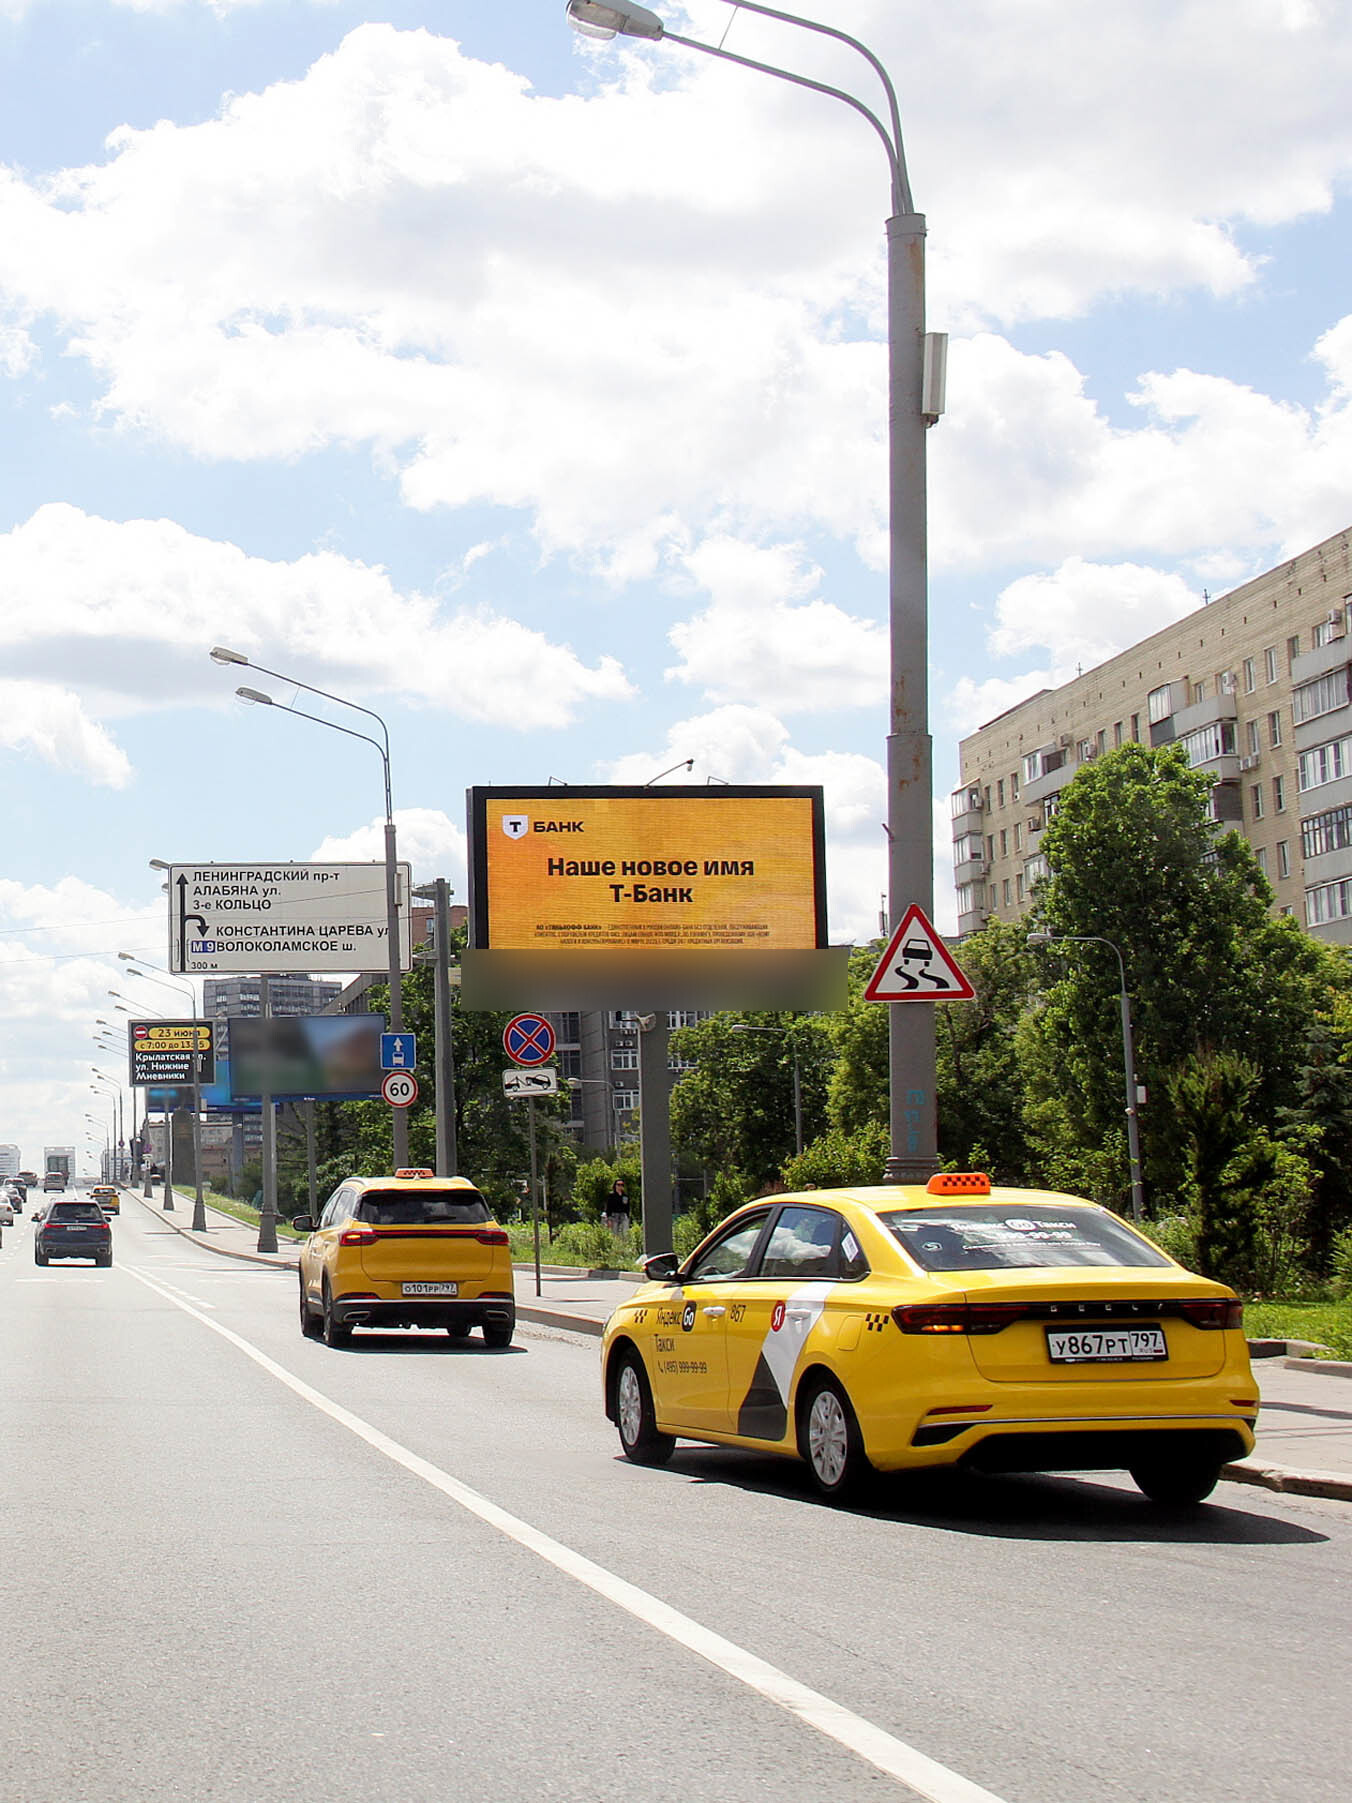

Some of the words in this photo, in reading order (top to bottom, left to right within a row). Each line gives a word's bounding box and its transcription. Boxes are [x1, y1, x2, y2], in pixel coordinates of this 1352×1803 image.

[509, 821, 522, 833] Т
[533, 821, 585, 833] БАНК
[547, 857, 616, 876] Наше
[621, 860, 698, 876] новое
[703, 860, 754, 876] имя
[192, 868, 309, 882] ЛЕНИНГРАДСКИЙ
[313, 873, 340, 883] пр-т
[193, 885, 258, 896] АЛАБЯНА
[262, 887, 281, 898] ул.
[609, 884, 694, 903] Т-Банк
[193, 900, 212, 910] 3-е
[215, 899, 272, 912] КОЛЬЦО
[216, 925, 315, 936] КОНСТАНТИНА
[319, 925, 374, 938] ЦАРЕВА
[216, 940, 338, 952] ВОЛОКОЛАМСКОЕ
[342, 943, 357, 951] ш.
[191, 961, 208, 970] 300
[158, 1028, 171, 1037] 23
[146, 1041, 167, 1049] 7:00
[135, 1053, 191, 1063] Крылатская
[135, 1064, 149, 1072] ул.
[151, 1062, 190, 1070] Нижние
[136, 1072, 185, 1080] Мневники
[390, 1082, 410, 1097] 60
[656, 1306, 682, 1328] Яндекс
[683, 1306, 694, 1326] Go
[730, 1304, 746, 1323] 867
[653, 1333, 675, 1352] Такси
[1055, 1334, 1129, 1355] У867РТ
[1130, 1332, 1159, 1348] 797
[679, 1360, 708, 1374] 999-99-99
